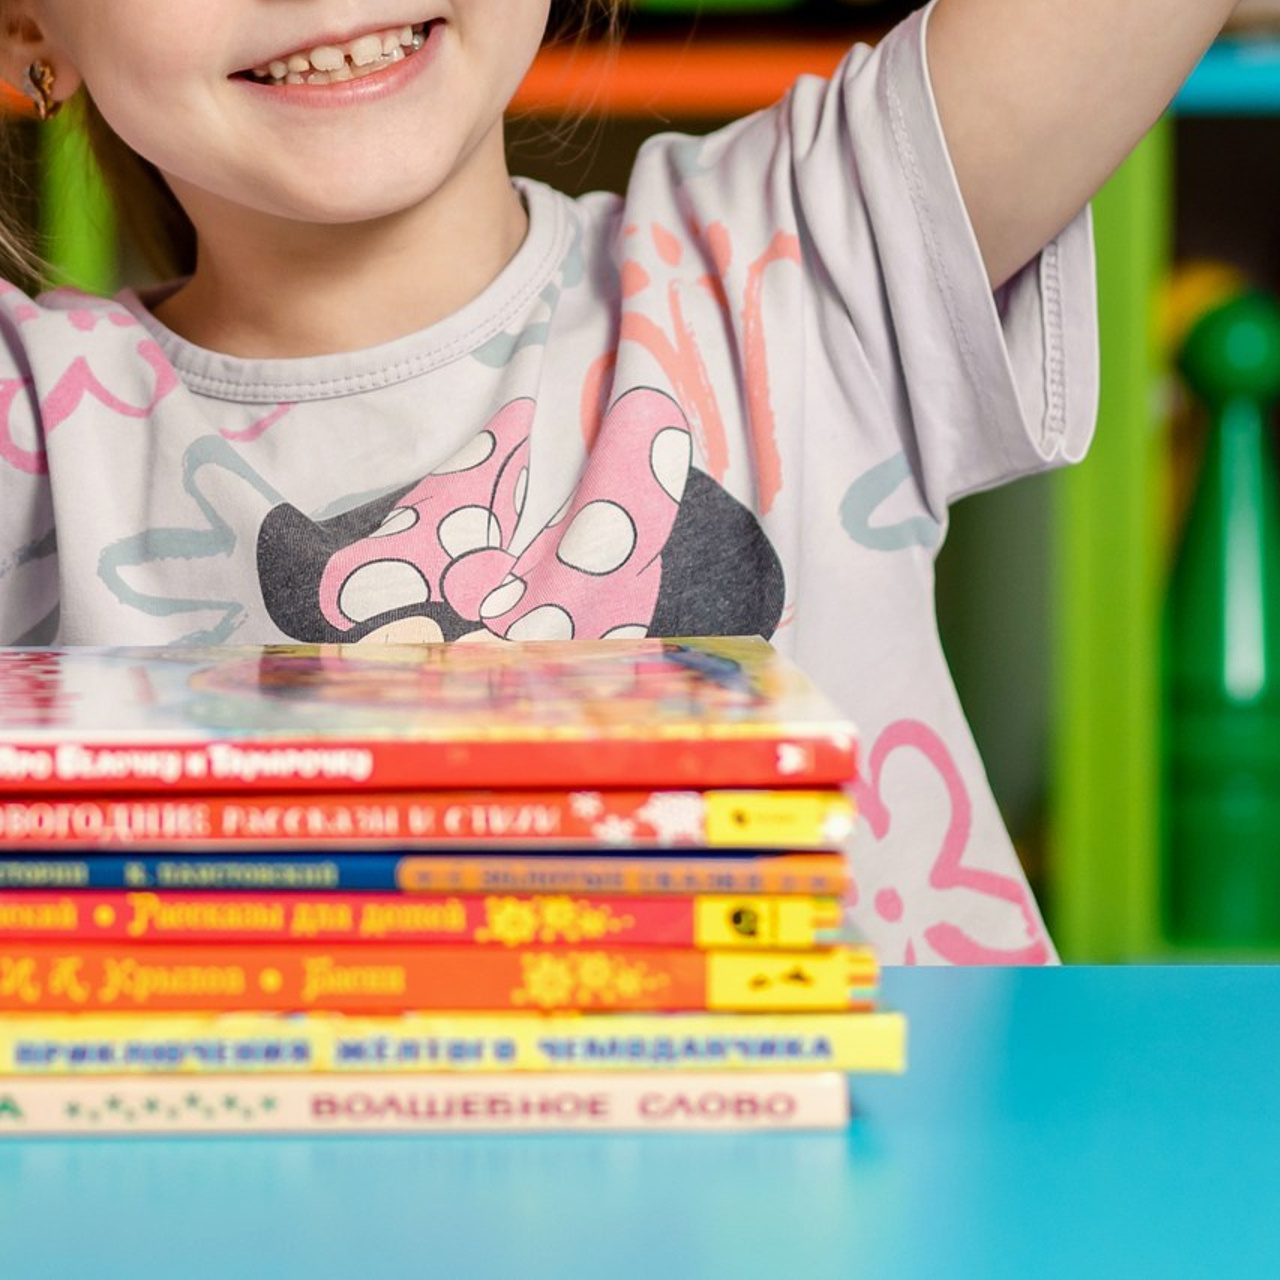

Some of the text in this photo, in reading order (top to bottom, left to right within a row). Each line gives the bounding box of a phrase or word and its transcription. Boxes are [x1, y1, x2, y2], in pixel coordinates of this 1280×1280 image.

[185, 750, 207, 778] и
[222, 804, 400, 837] РАССКАЗЫ
[126, 891, 285, 937] Рассказы
[290, 901, 354, 937] для
[359, 896, 468, 938] детей
[98, 956, 246, 1003] Крылов
[300, 954, 407, 1003] Басни
[14, 1040, 310, 1066] ПРИКЛЮЧЕНИЯ
[336, 1035, 518, 1064] ЖЁЛТОГО
[538, 1036, 832, 1064] ЧЕМОДАНЧИКА
[310, 1091, 611, 1120] ВОЛШЕБНОЕ
[637, 1091, 799, 1119] СЛОВО
